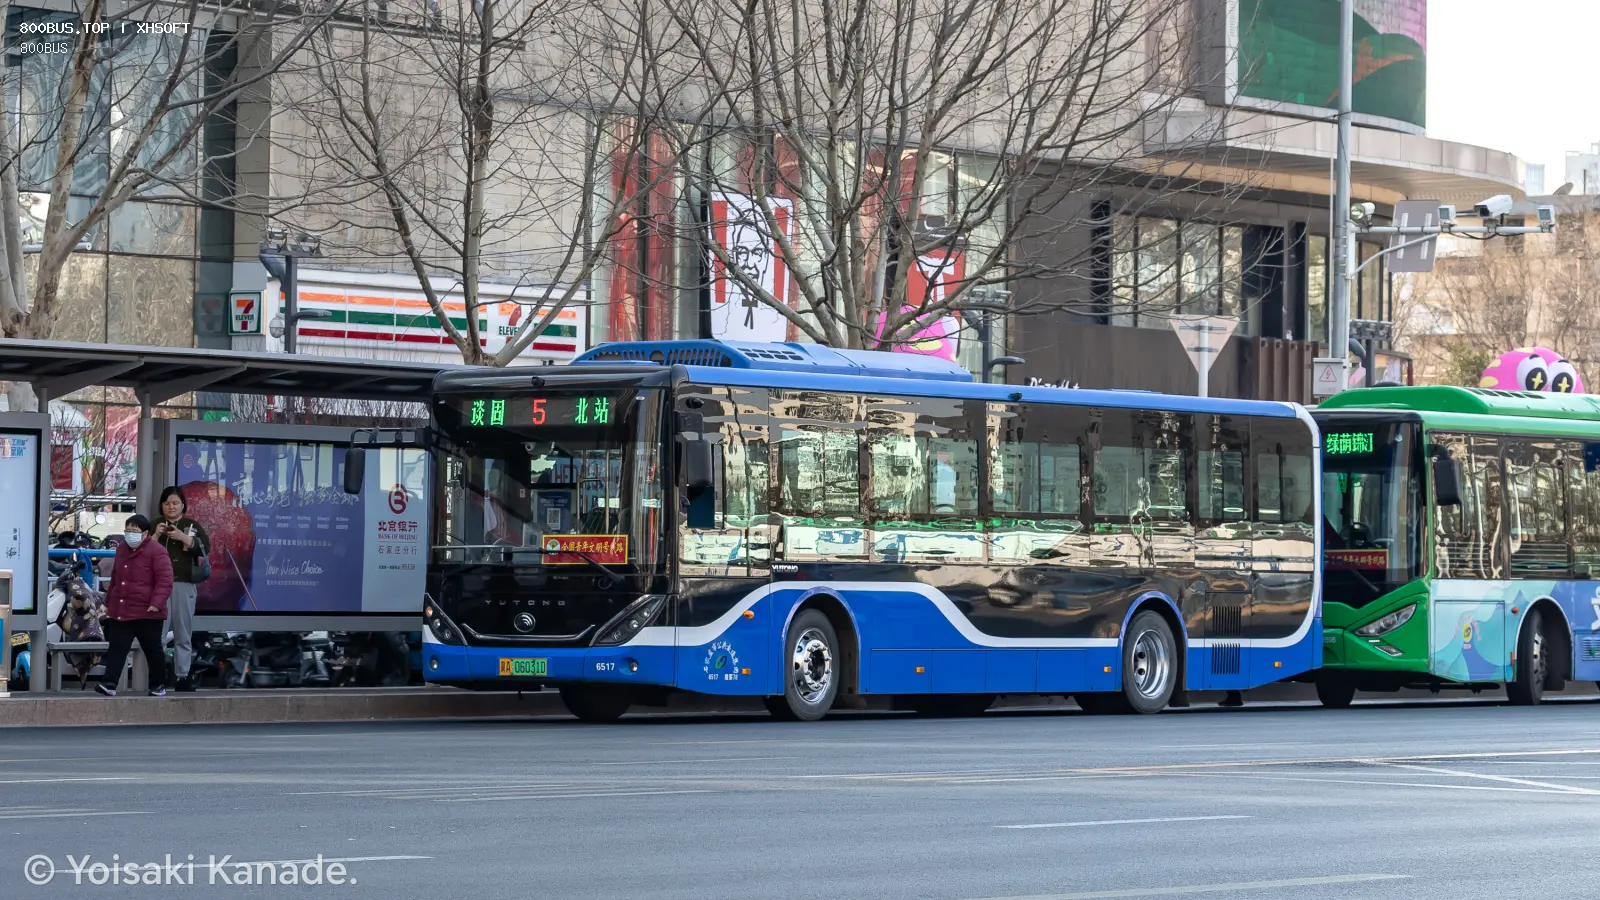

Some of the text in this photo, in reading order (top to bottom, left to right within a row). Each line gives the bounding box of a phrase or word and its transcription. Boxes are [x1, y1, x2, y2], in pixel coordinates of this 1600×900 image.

[498, 325, 521, 336] ELEVE
[471, 397, 609, 426] 谈固 5 北站
[378, 520, 418, 533] 北京银行
[378, 545, 418, 556] 石家庄分行
[264, 556, 325, 576] Your Wise Choice
[596, 662, 615, 671] 6517
